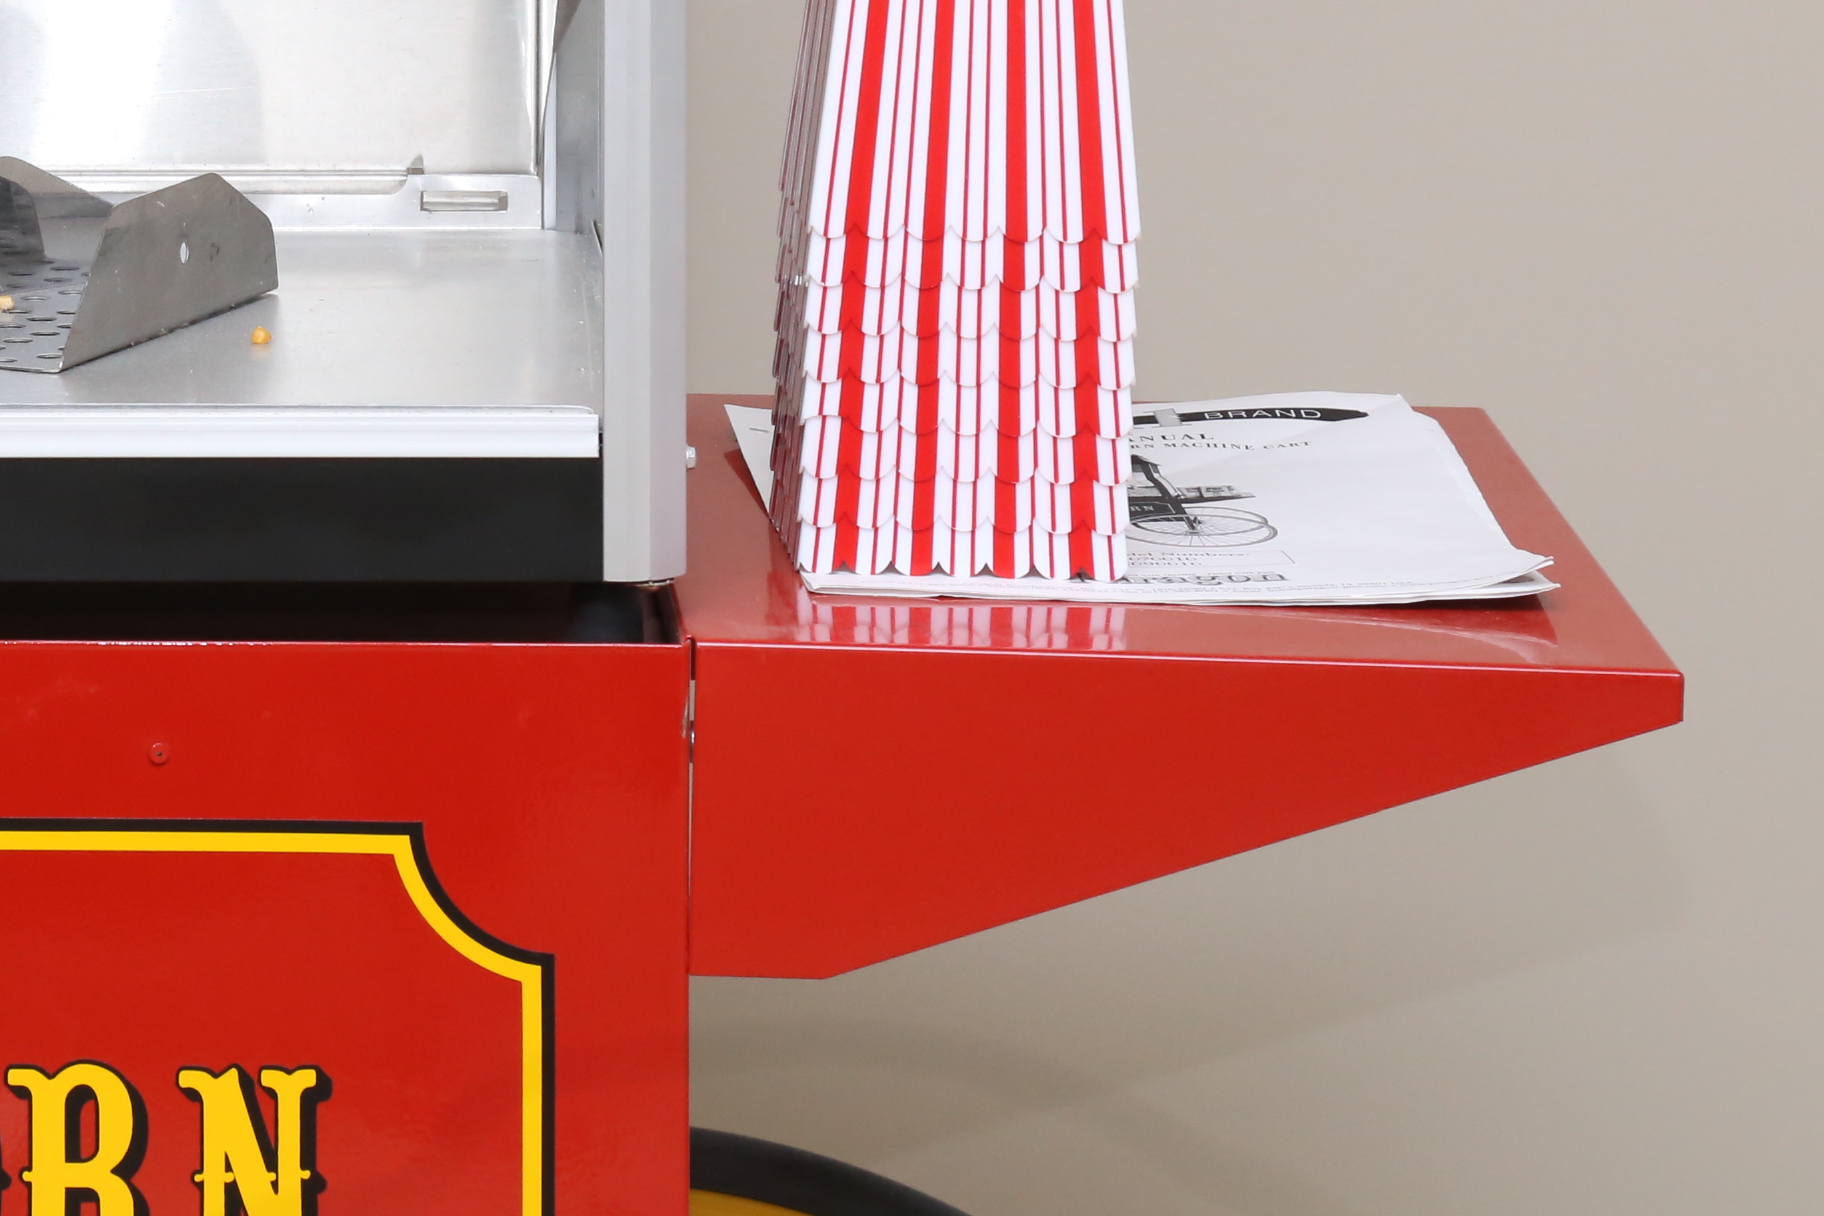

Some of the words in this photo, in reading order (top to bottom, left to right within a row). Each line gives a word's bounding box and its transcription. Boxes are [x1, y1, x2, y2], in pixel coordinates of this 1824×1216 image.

[1204, 409, 1321, 420] BRAND
[1163, 442, 1255, 451] MACHINE
[1263, 441, 1311, 449] CART
[1113, 572, 1290, 585] aragon
